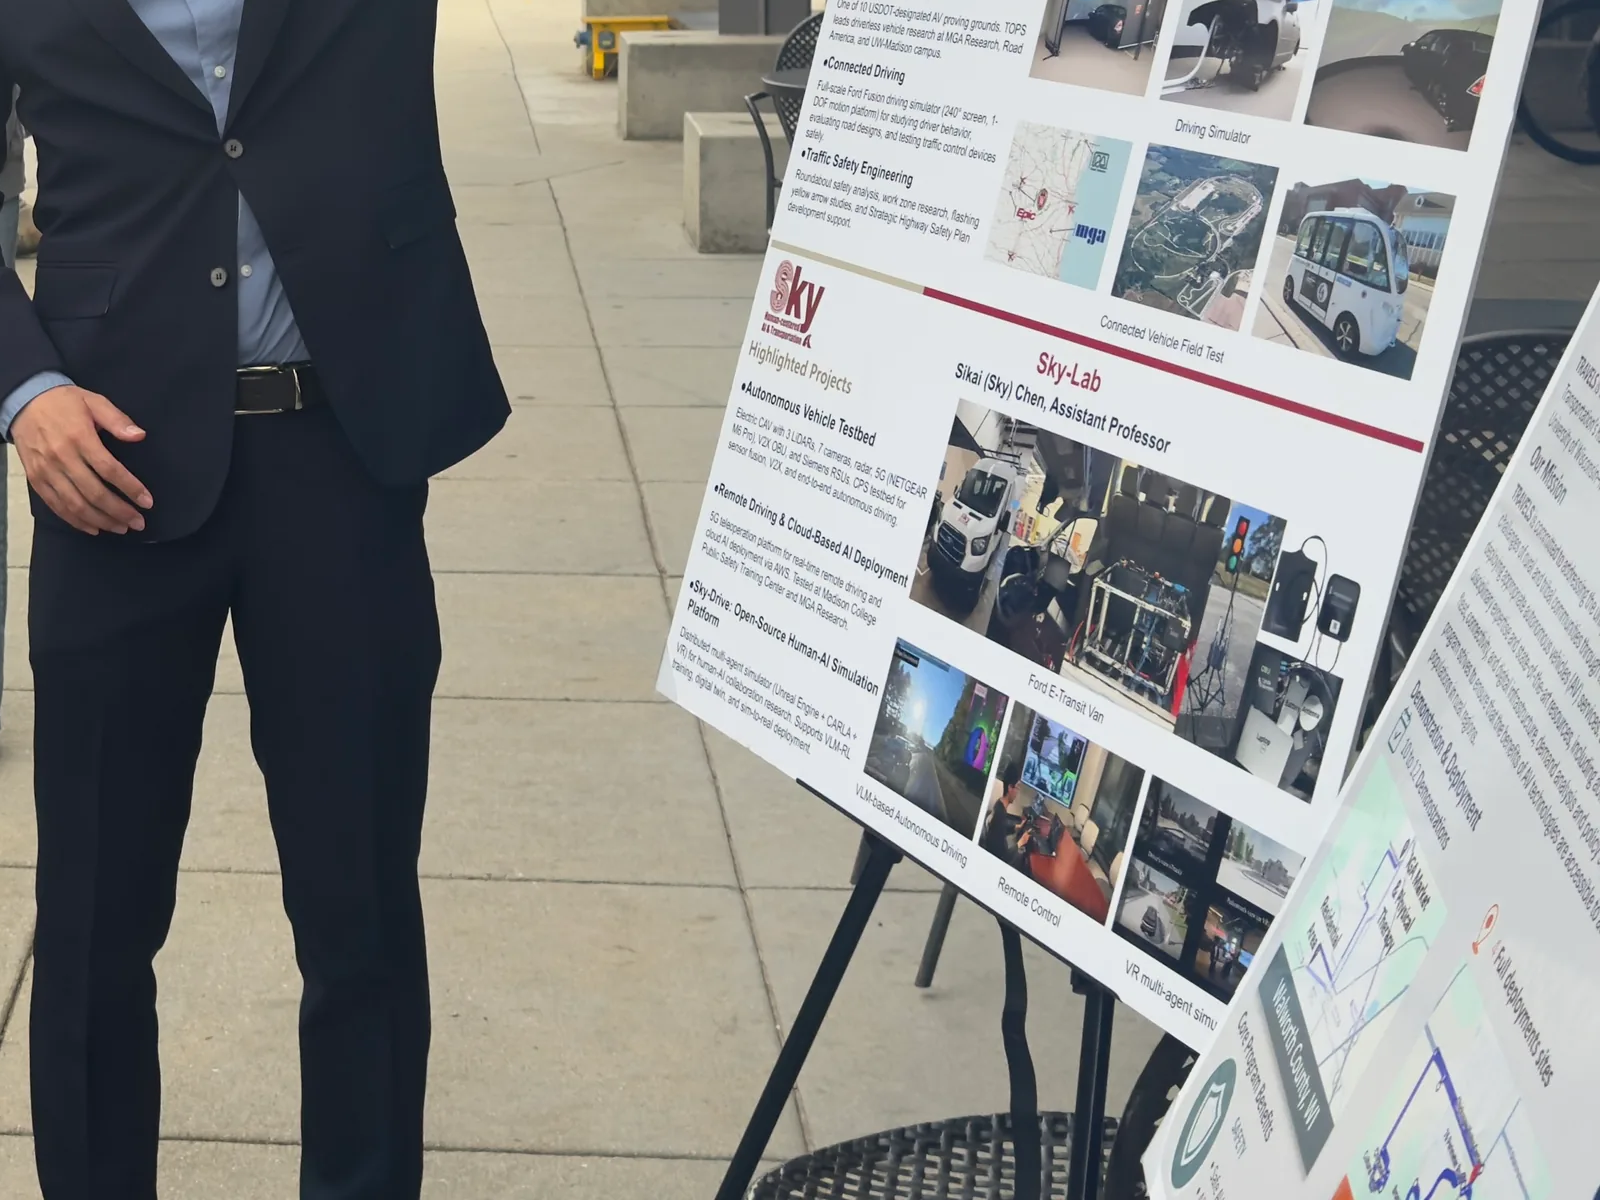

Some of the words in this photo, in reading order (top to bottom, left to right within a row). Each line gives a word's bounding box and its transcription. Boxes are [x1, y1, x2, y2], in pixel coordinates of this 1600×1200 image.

[827, 55, 873, 76] Connected
[872, 63, 905, 86] Driving
[1174, 117, 1206, 139] Driving
[1207, 124, 1251, 144] Simulator
[805, 146, 831, 165] Traffic
[831, 153, 860, 175] Safety
[859, 160, 913, 189] Engineering
[1015, 207, 1036, 221] Epic
[1074, 223, 1106, 245] mga
[769, 258, 826, 330] Sky
[747, 339, 809, 376] Highlighted
[808, 362, 852, 394] Projects
[1099, 314, 1146, 340] Connected
[1147, 328, 1179, 350] Vehicle
[1179, 337, 1204, 357] Field
[1205, 345, 1224, 364] Test
[1036, 351, 1101, 392] Sky-Lab
[744, 380, 801, 415] Autonomous
[803, 402, 836, 430] Vehicle
[838, 417, 877, 446] Testbed
[954, 362, 983, 386] Sikai
[982, 372, 1013, 400] (Sky)
[1014, 383, 1046, 412] Chen,
[1048, 396, 1107, 431] Assistant
[1107, 416, 1171, 453] Professor
[1529, 444, 1546, 474] Our
[1540, 458, 1567, 505] Mission
[717, 482, 748, 508] Remote
[748, 496, 778, 526] Driving
[777, 512, 786, 526] &
[786, 516, 842, 554] Cloud-Based
[840, 543, 853, 560] AI
[852, 548, 908, 588] Deployment
[686, 597, 720, 627] Platform
[692, 579, 732, 612] Sky-Drive:
[733, 602, 786, 643] Open-Source
[786, 632, 831, 668] Human-AI
[830, 657, 879, 696] Simulation
[1027, 672, 1048, 694] Ford
[1047, 683, 1087, 715] E-Transit
[1088, 703, 1104, 724] Van
[1409, 678, 1445, 756] Demonstration
[1439, 741, 1453, 766] &
[1444, 751, 1483, 832] Deployment
[855, 782, 895, 818] VLM-based
[893, 809, 940, 848] Autonomous
[940, 838, 968, 869] Driving
[997, 875, 1030, 907] Remote
[1030, 897, 1061, 927] Control
[1125, 958, 1140, 981] VR
[1139, 973, 1193, 1016] multi-agent
[1492, 945, 1512, 980] Full
[1502, 969, 1541, 1057] deployments
[1534, 1048, 1554, 1088] sites
[1236, 1010, 1250, 1046] Core
[1243, 1035, 1261, 1093] Program
[1254, 1082, 1274, 1142] Benefits
[1272, 977, 1299, 1055] Walworth
[1289, 1041, 1310, 1110] County,
[1303, 1093, 1320, 1131] WI
